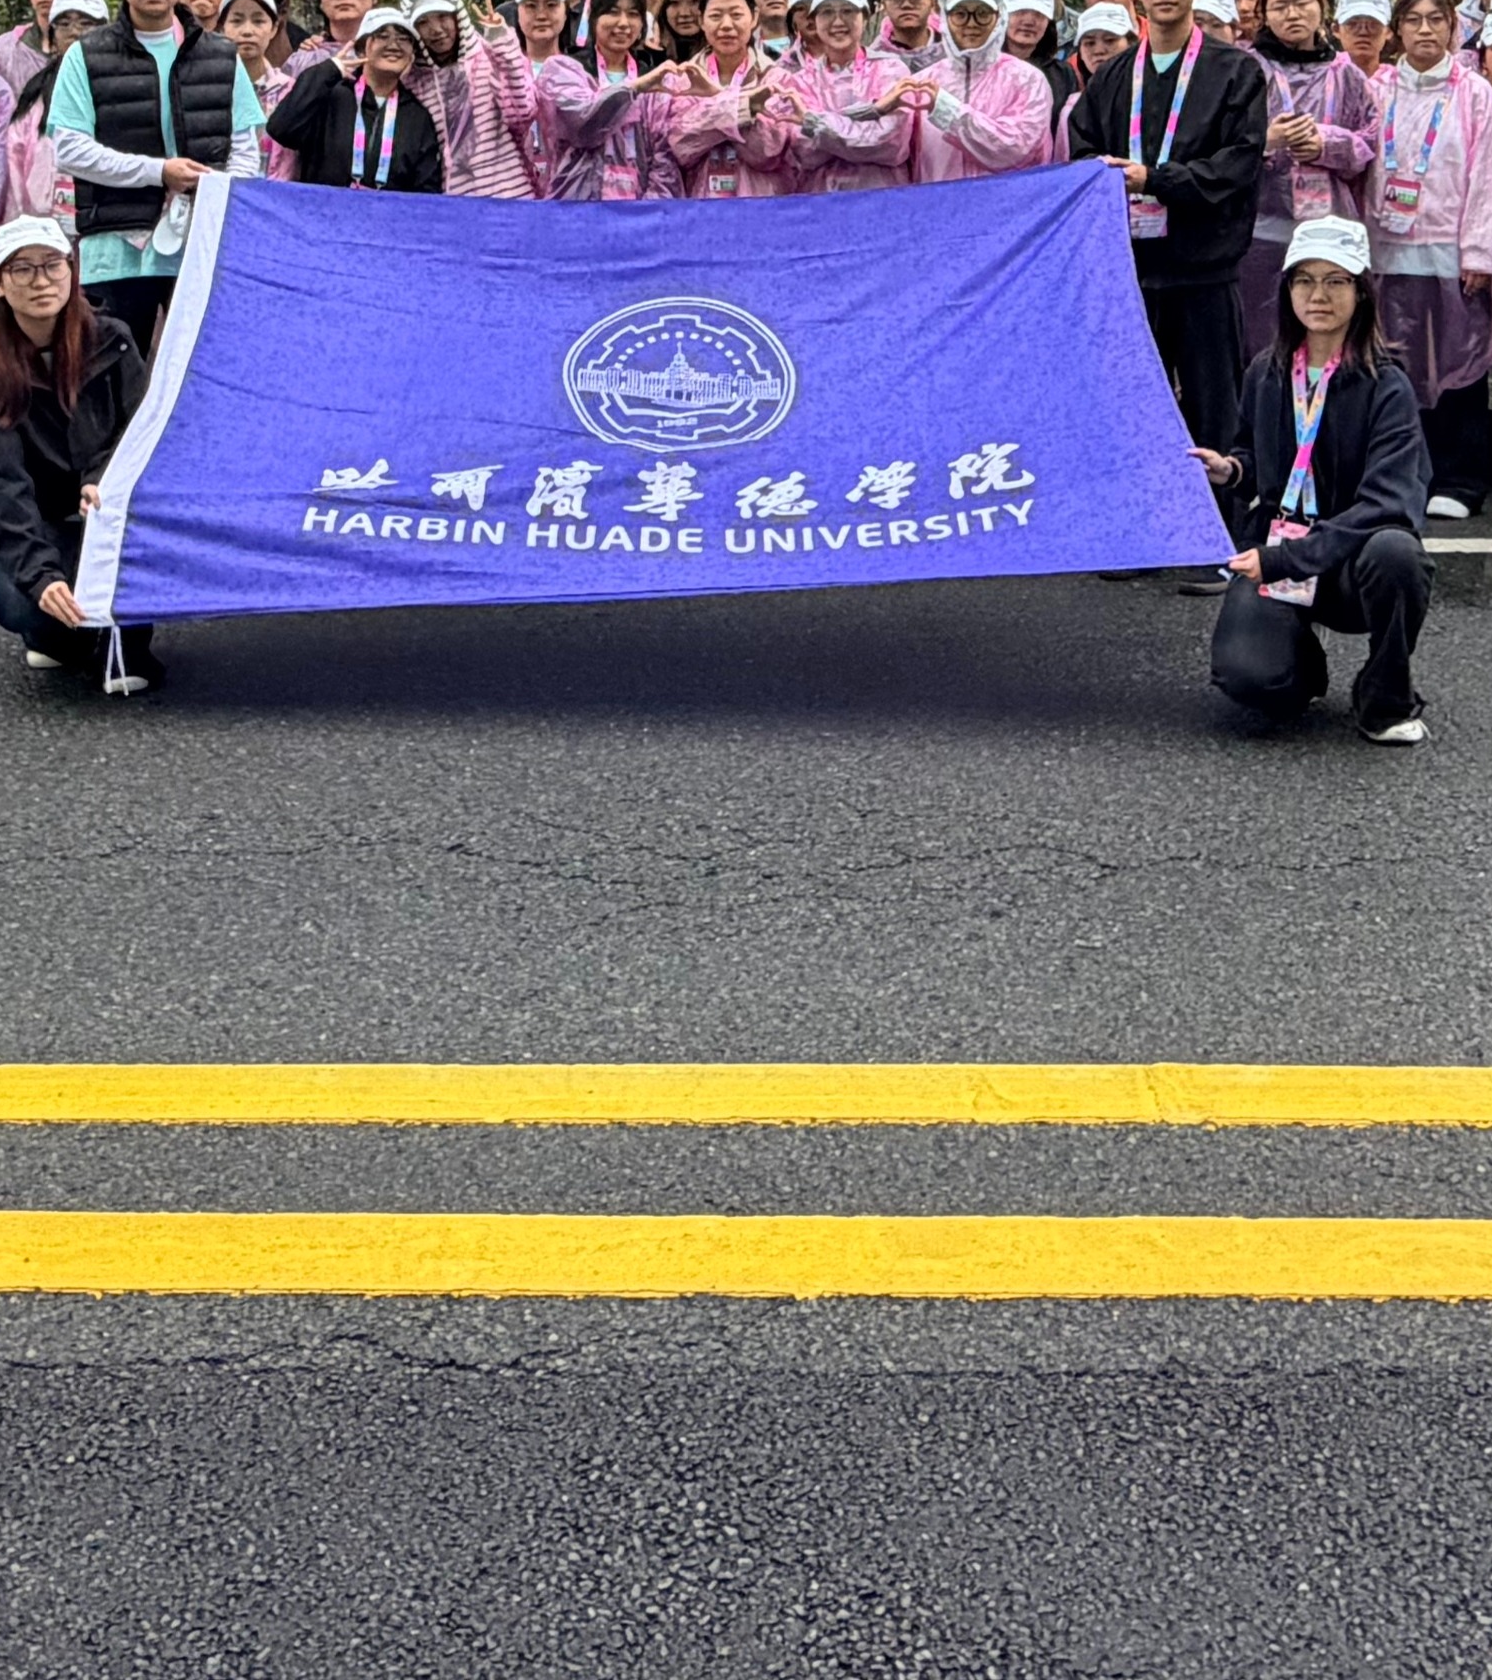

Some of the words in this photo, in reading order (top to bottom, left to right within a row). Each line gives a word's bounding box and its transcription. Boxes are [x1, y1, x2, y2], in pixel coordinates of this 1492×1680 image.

[302, 506, 506, 545] HARBIN
[526, 522, 703, 553] HUADE
[724, 498, 1035, 554] UNIVERSITY
